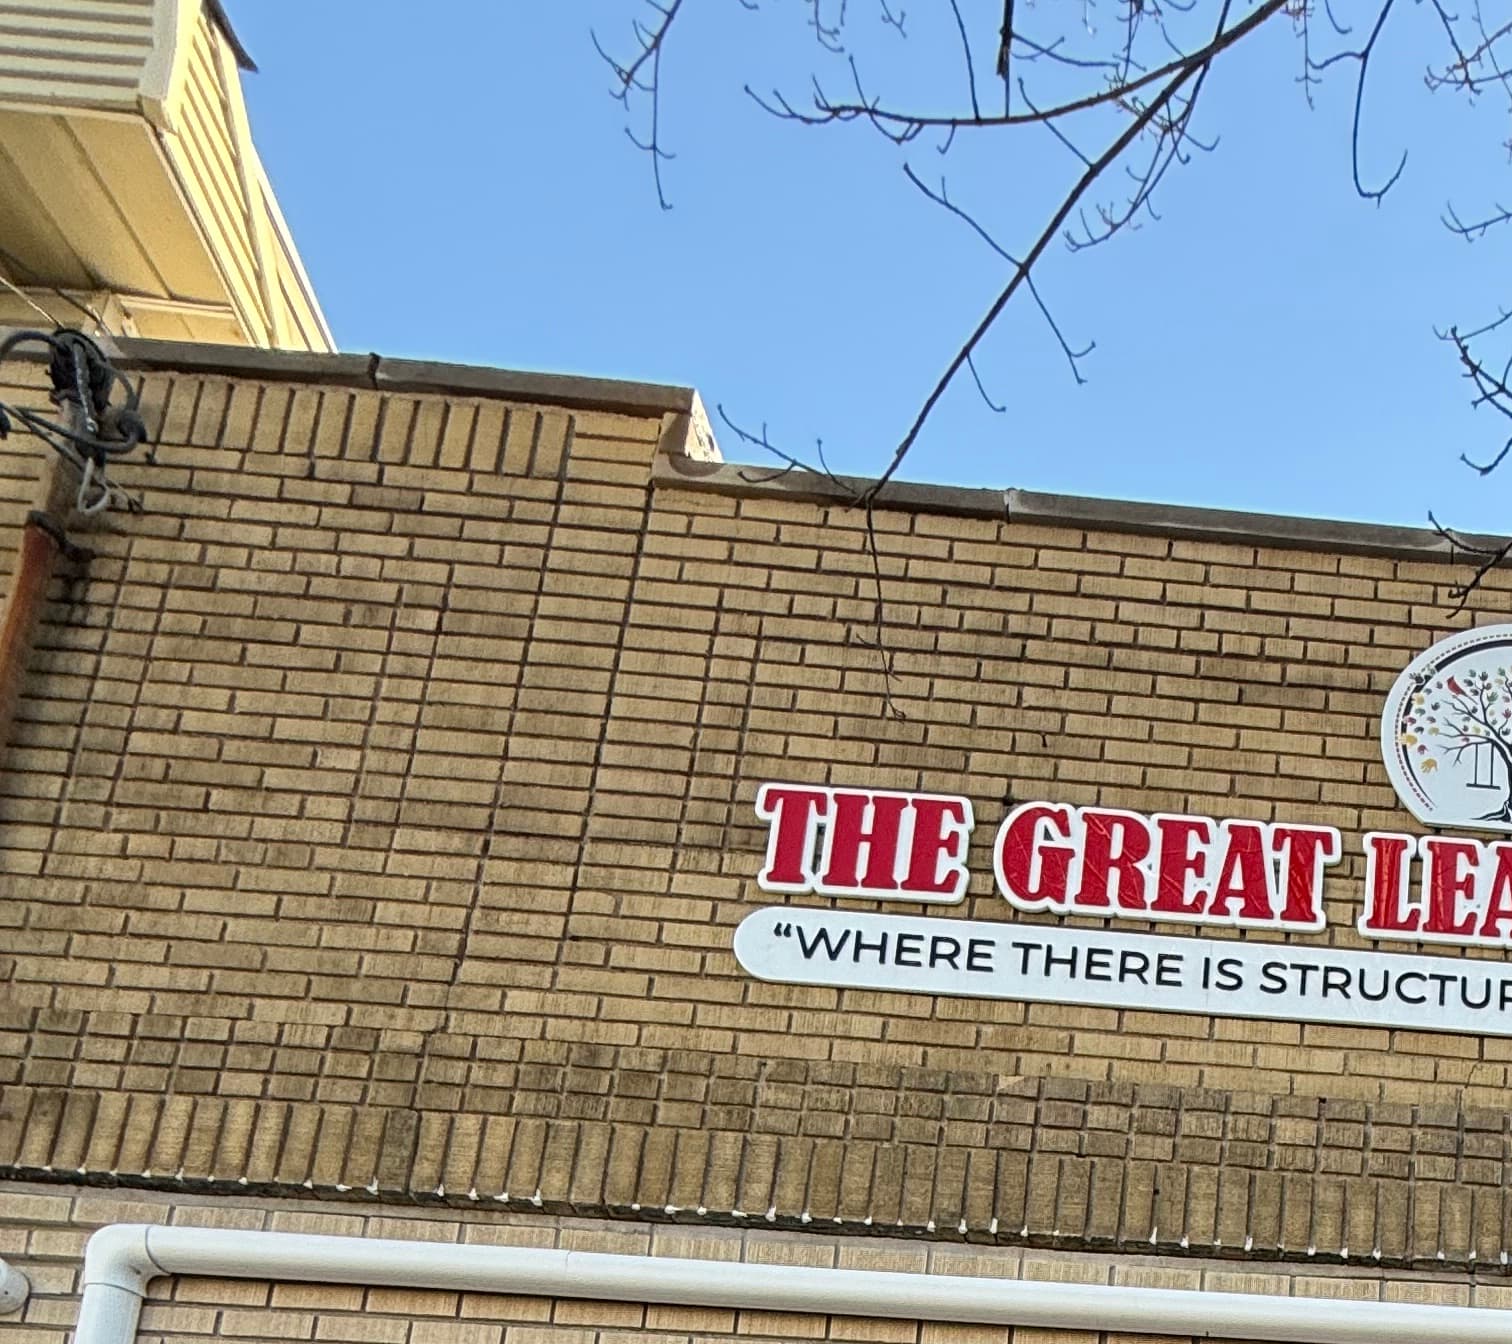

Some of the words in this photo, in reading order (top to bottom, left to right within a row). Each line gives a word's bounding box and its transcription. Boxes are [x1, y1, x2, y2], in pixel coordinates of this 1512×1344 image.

[763, 788, 965, 894] THE
[1001, 806, 1334, 923] GREAT
[1012, 942, 1183, 987] THERE
[1202, 957, 1243, 991] IS
